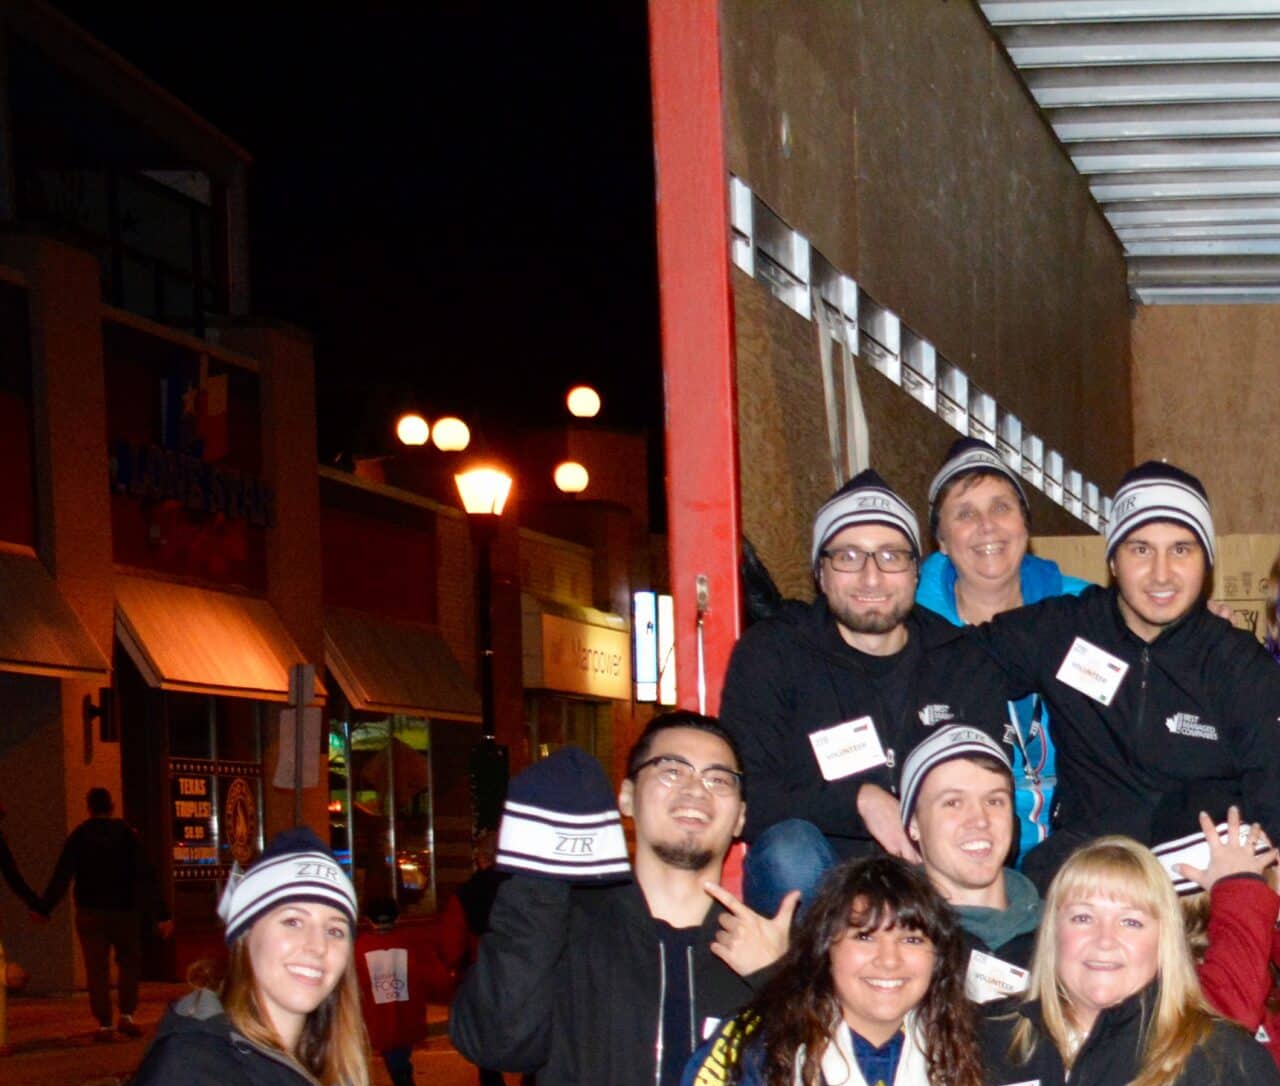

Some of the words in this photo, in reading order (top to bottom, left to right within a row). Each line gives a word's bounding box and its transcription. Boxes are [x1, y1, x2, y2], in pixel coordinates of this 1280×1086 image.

[857, 496, 892, 511] ZTR
[952, 730, 986, 743] ZTR
[826, 742, 867, 760] VOLUNTEER
[554, 833, 595, 854] ZTR
[296, 862, 339, 880] ZTR
[975, 973, 1014, 991] VOLUNTEER
